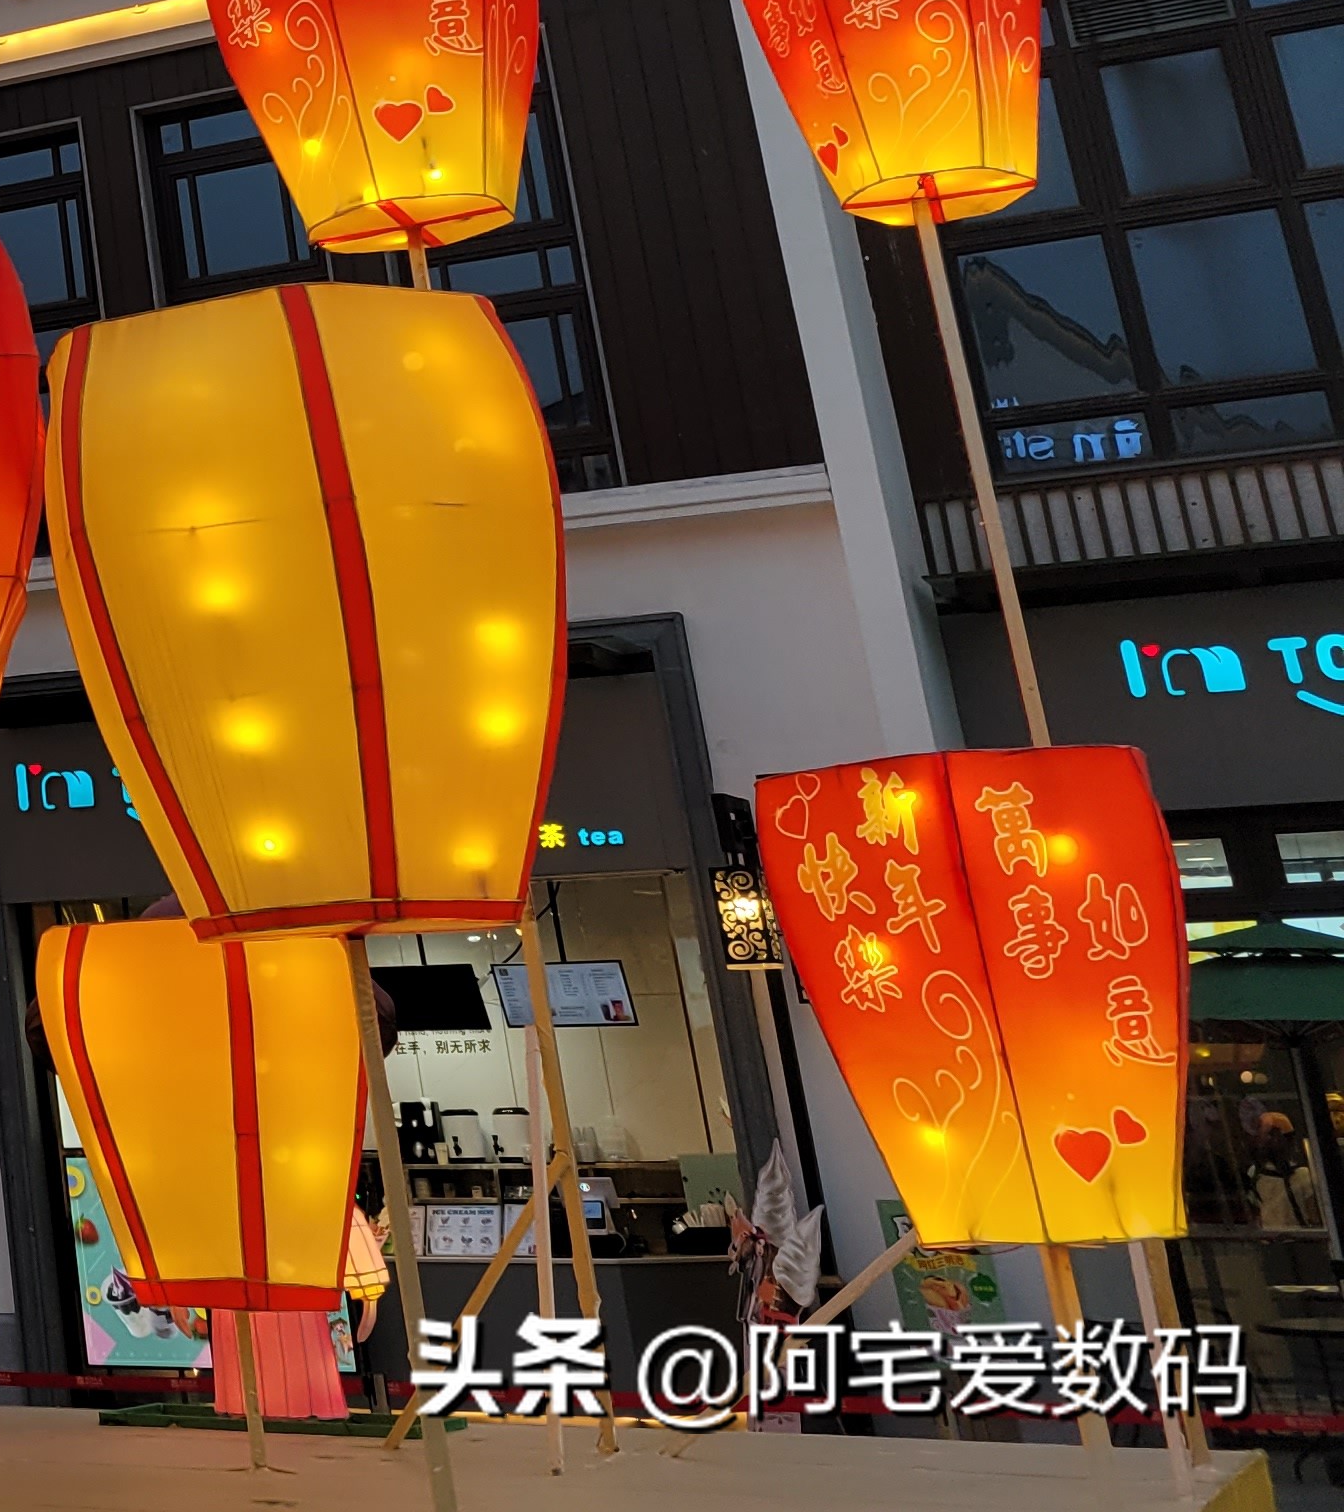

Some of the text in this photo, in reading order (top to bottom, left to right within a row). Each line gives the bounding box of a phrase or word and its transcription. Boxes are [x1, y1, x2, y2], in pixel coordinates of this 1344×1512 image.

[538, 823, 566, 848] 茶
[577, 828, 624, 846] tea
[856, 767, 945, 954] 新年
[975, 781, 1069, 979] 萬事
[1078, 874, 1178, 1067] 如意
